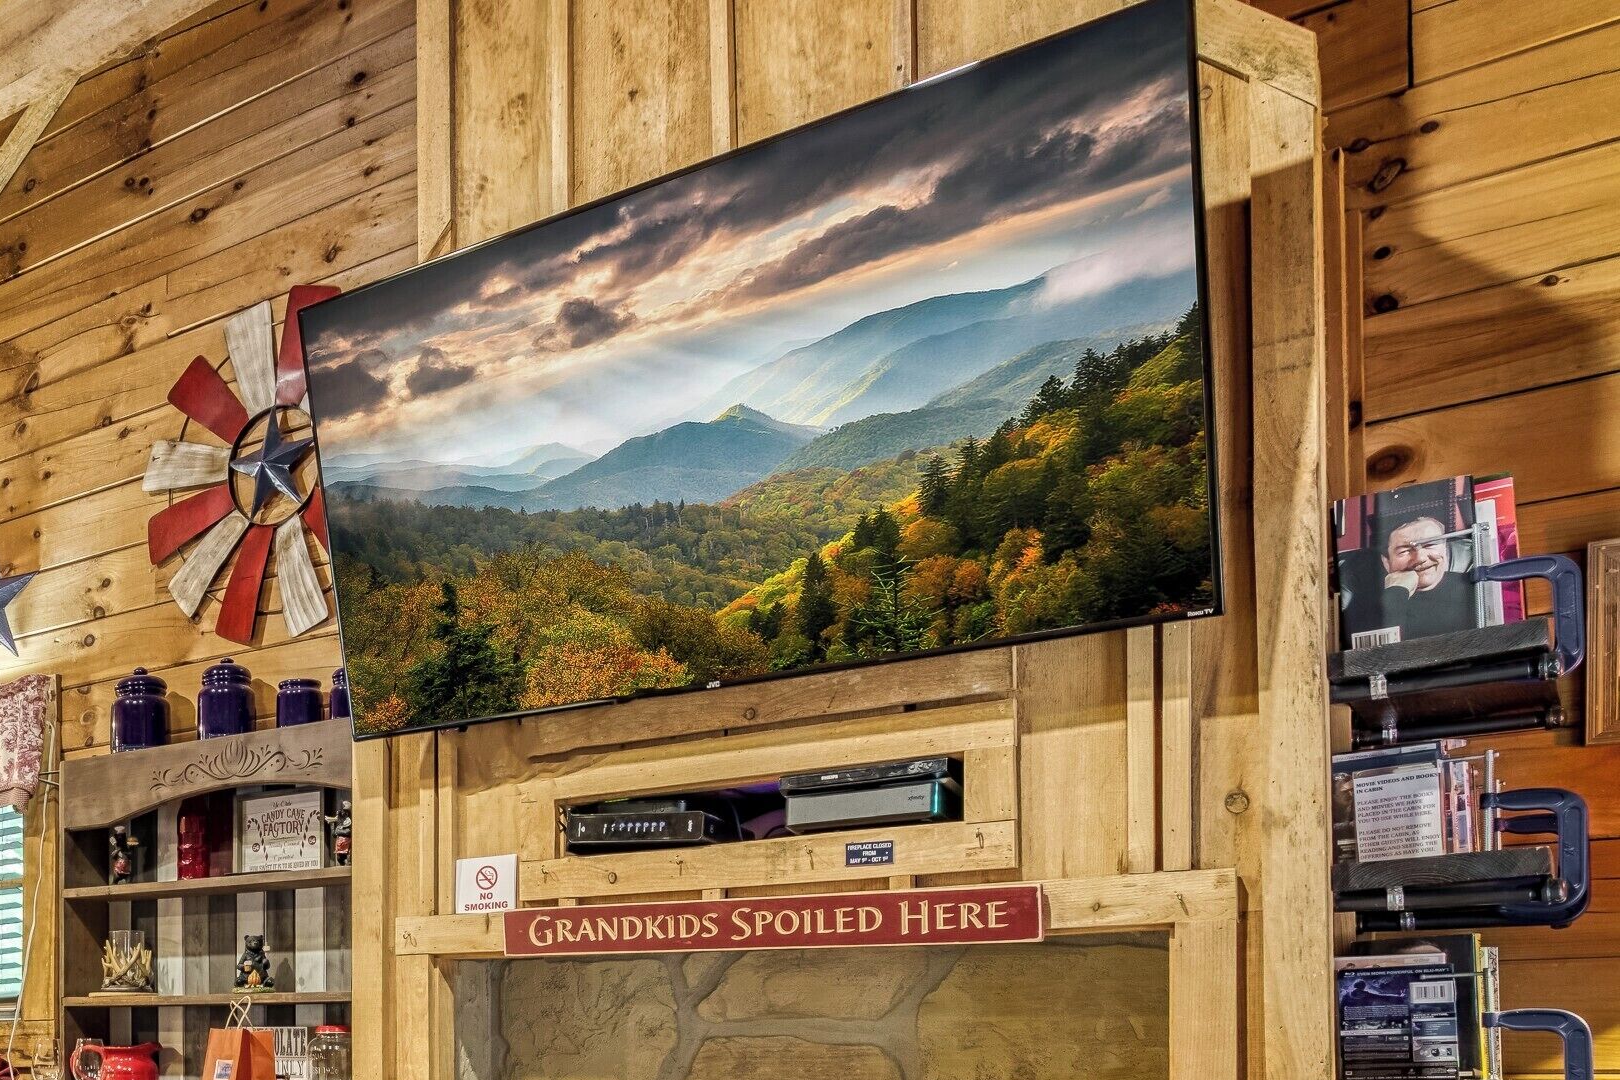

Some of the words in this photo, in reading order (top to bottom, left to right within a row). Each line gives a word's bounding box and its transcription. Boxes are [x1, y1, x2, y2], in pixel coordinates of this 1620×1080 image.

[262, 809, 284, 823] CANDY
[286, 808, 305, 820] CANE
[263, 820, 304, 838] FACTORY
[480, 892, 493, 900] NO
[464, 901, 508, 911] SMOKING
